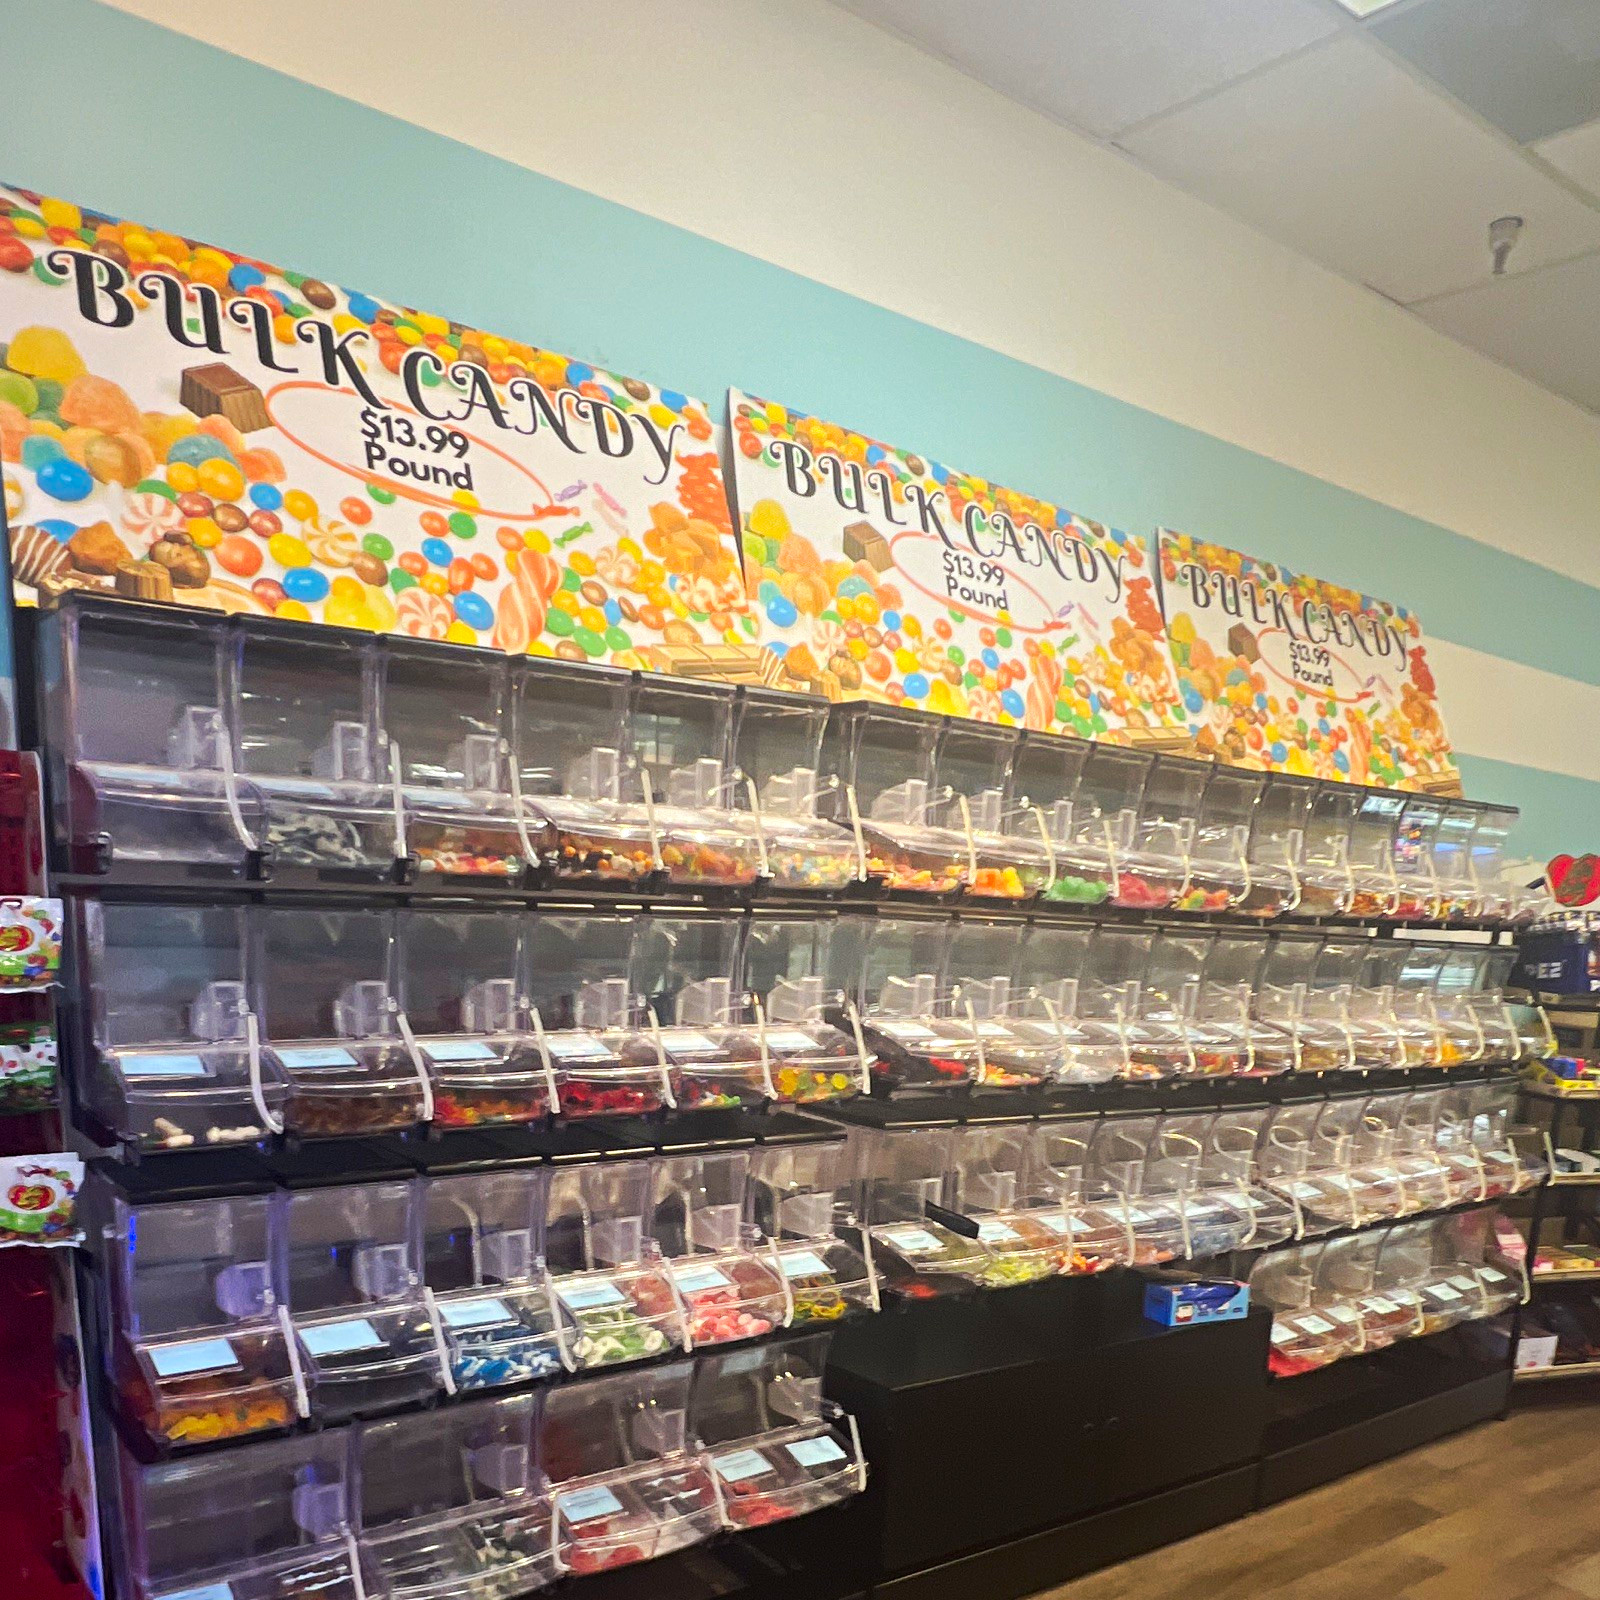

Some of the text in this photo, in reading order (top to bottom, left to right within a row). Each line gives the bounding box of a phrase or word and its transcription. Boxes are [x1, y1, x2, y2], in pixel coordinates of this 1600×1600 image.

[48, 250, 685, 484] BULK CANDY
[360, 407, 470, 458] $13.99
[364, 440, 473, 491] Pound
[770, 441, 1127, 603] BULK CANDY
[943, 550, 1005, 586] $13.99
[947, 575, 1008, 611] Pound
[1182, 564, 1409, 672] BULK CANDY
[1289, 642, 1330, 666] $13.99
[1292, 661, 1334, 686] Pound
